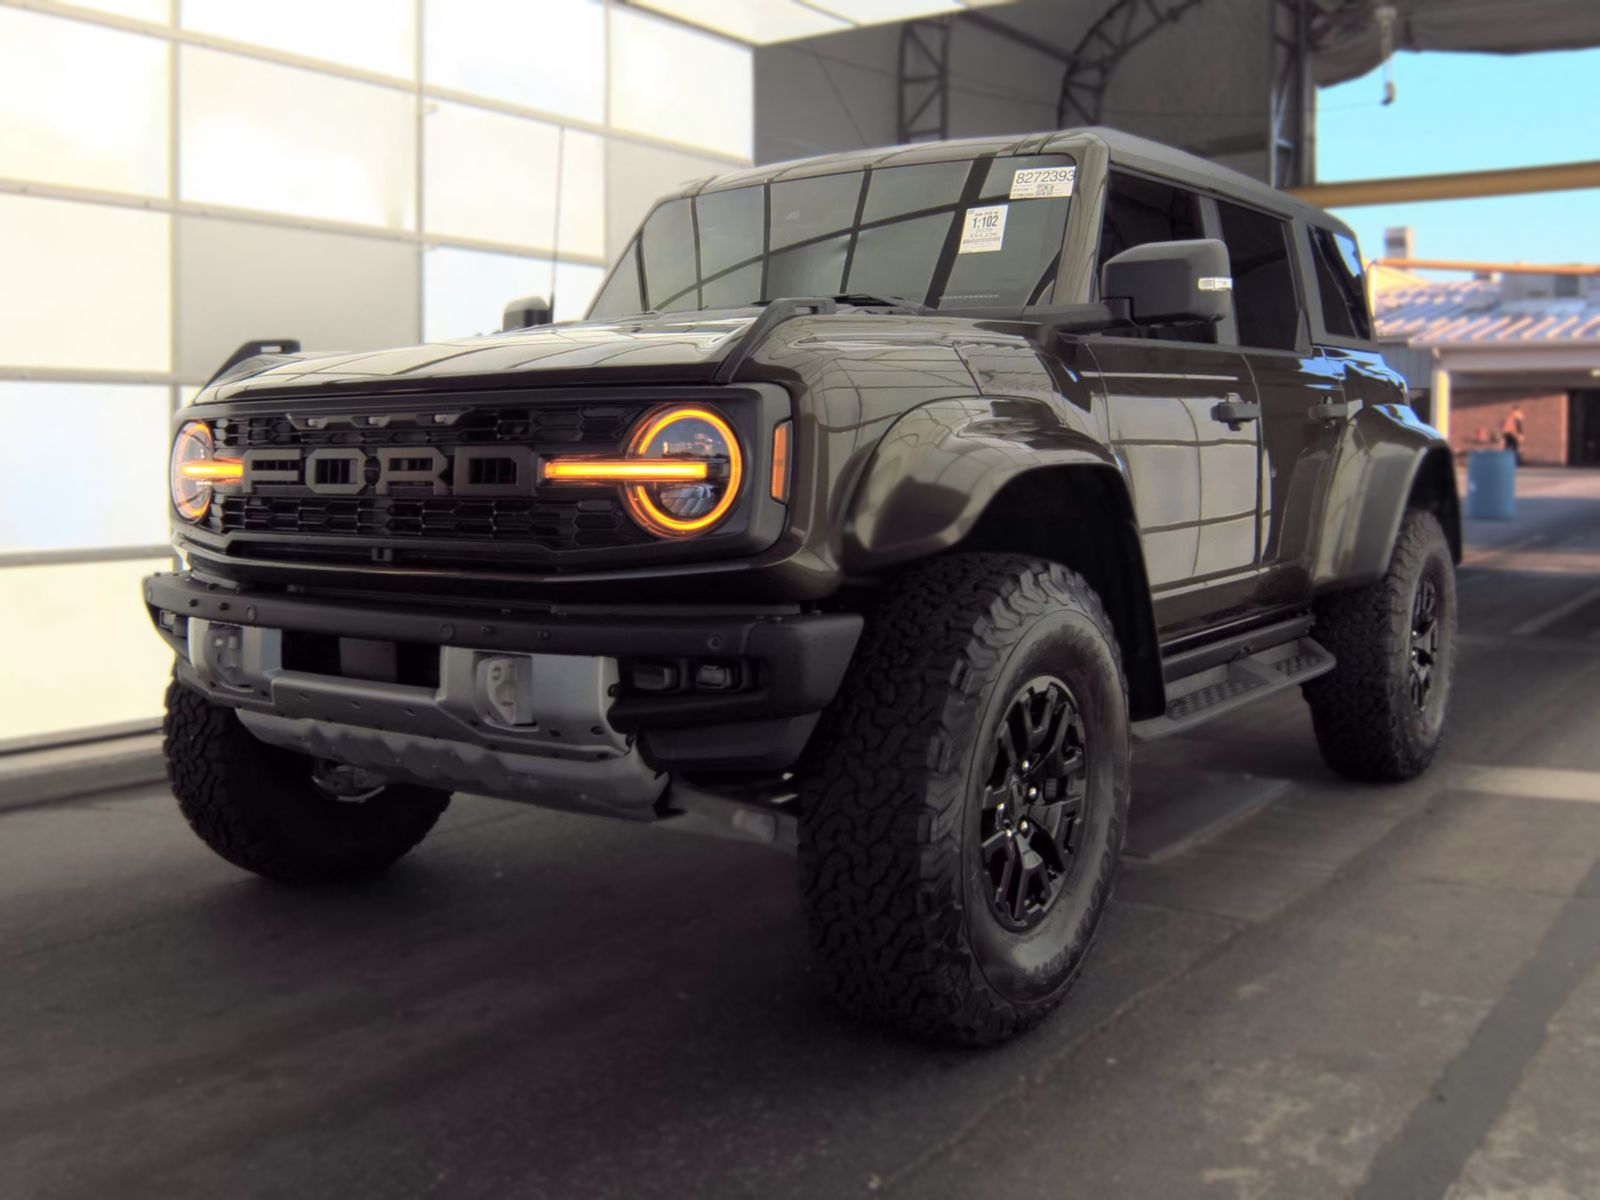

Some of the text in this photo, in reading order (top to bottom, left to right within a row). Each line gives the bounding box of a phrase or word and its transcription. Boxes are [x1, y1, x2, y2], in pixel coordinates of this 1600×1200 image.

[1016, 170, 1075, 184] 8272393
[972, 215, 999, 229] 1:102
[243, 446, 535, 496] FORD
